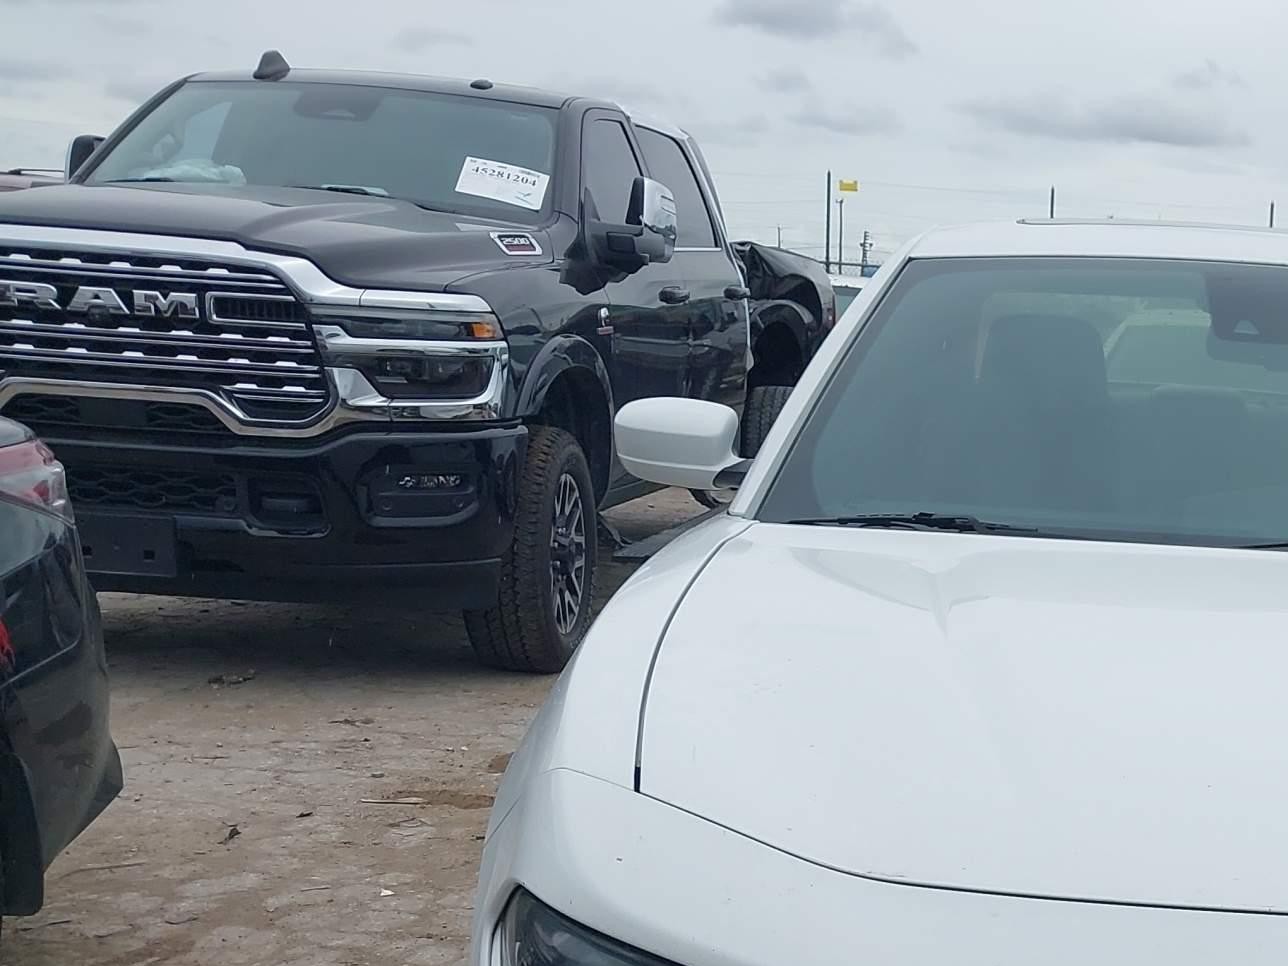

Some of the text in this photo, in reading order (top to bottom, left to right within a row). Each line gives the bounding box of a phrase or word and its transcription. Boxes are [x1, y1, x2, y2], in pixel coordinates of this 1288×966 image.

[471, 166, 537, 187] 45281204
[501, 237, 530, 245] 2500
[0, 280, 200, 318] RAM
